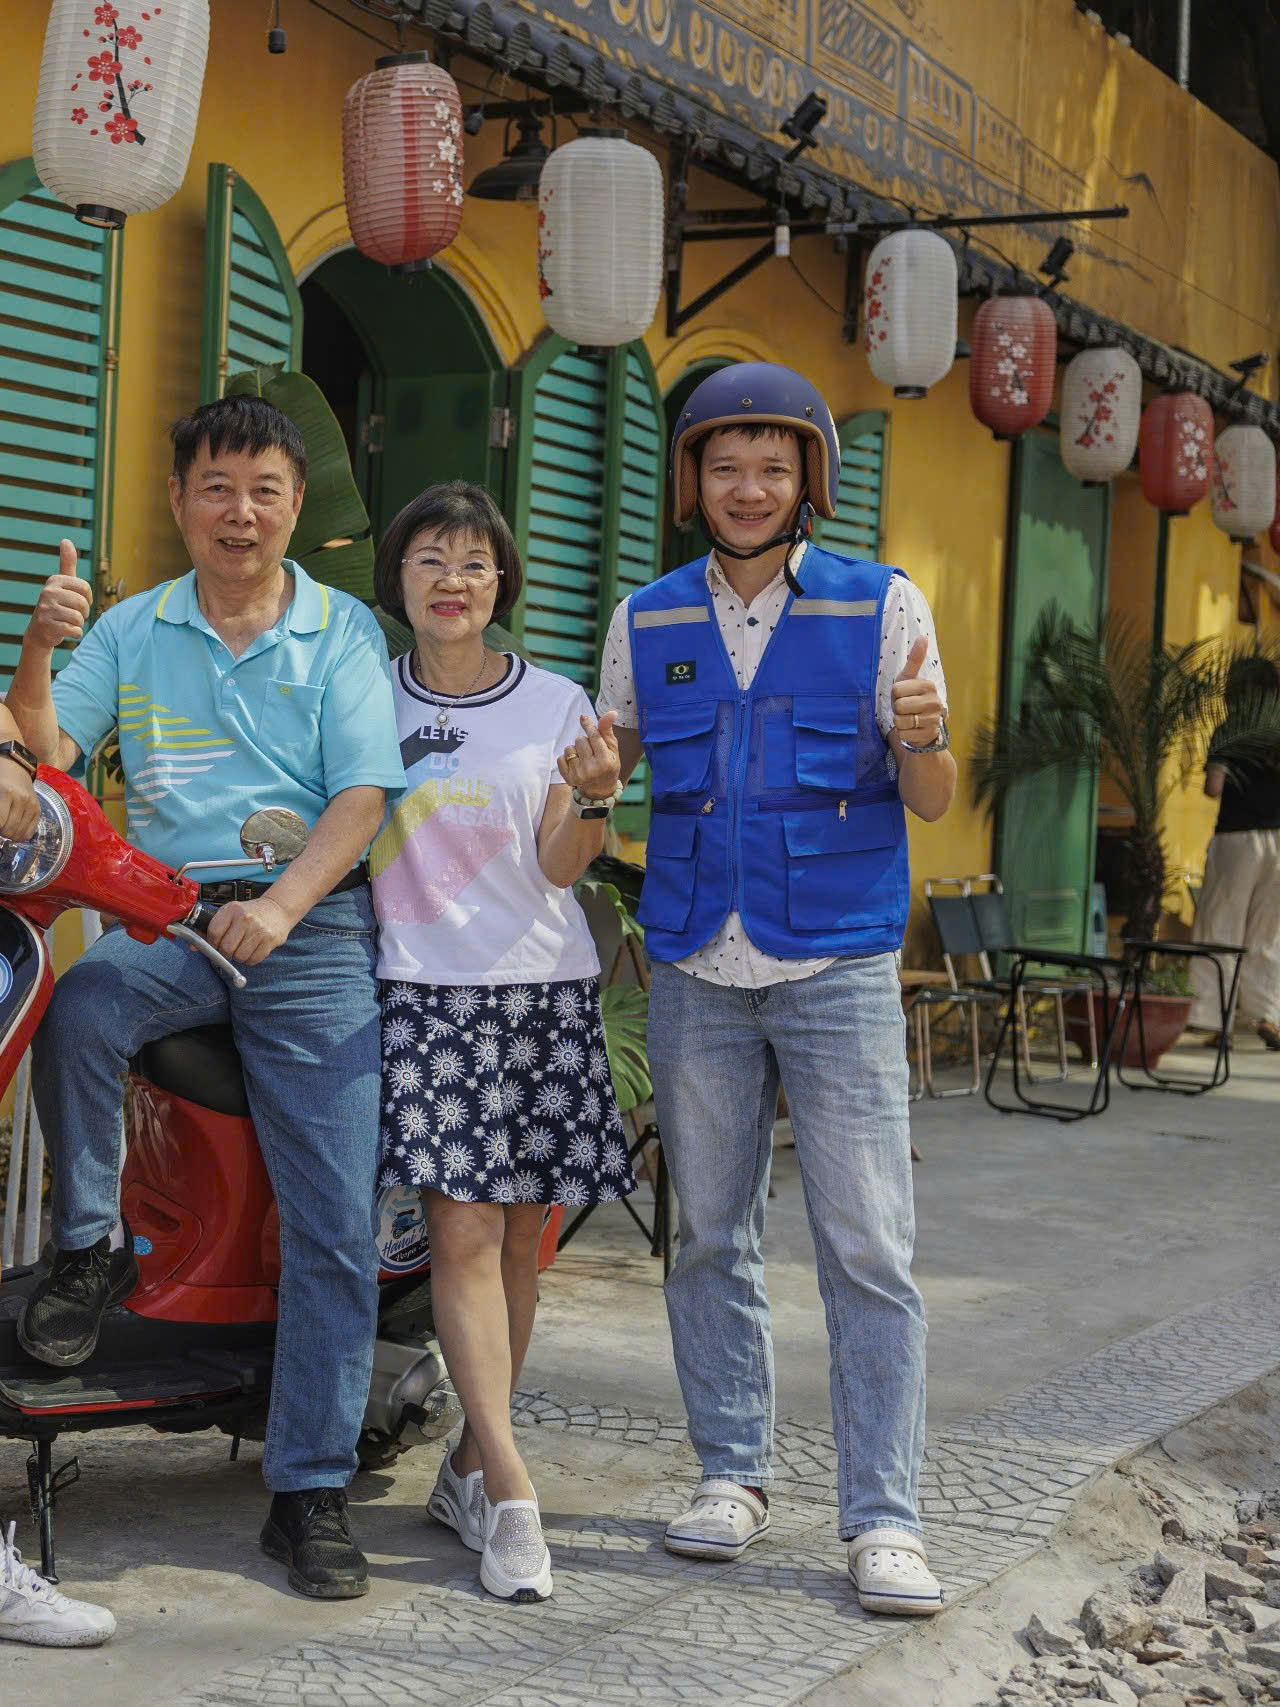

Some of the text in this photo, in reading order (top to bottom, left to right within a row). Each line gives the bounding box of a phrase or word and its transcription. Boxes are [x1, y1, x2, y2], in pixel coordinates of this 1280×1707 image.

[419, 725, 469, 742] LET'S
[429, 752, 463, 770] DO
[382, 1228, 417, 1258] Hanoi
